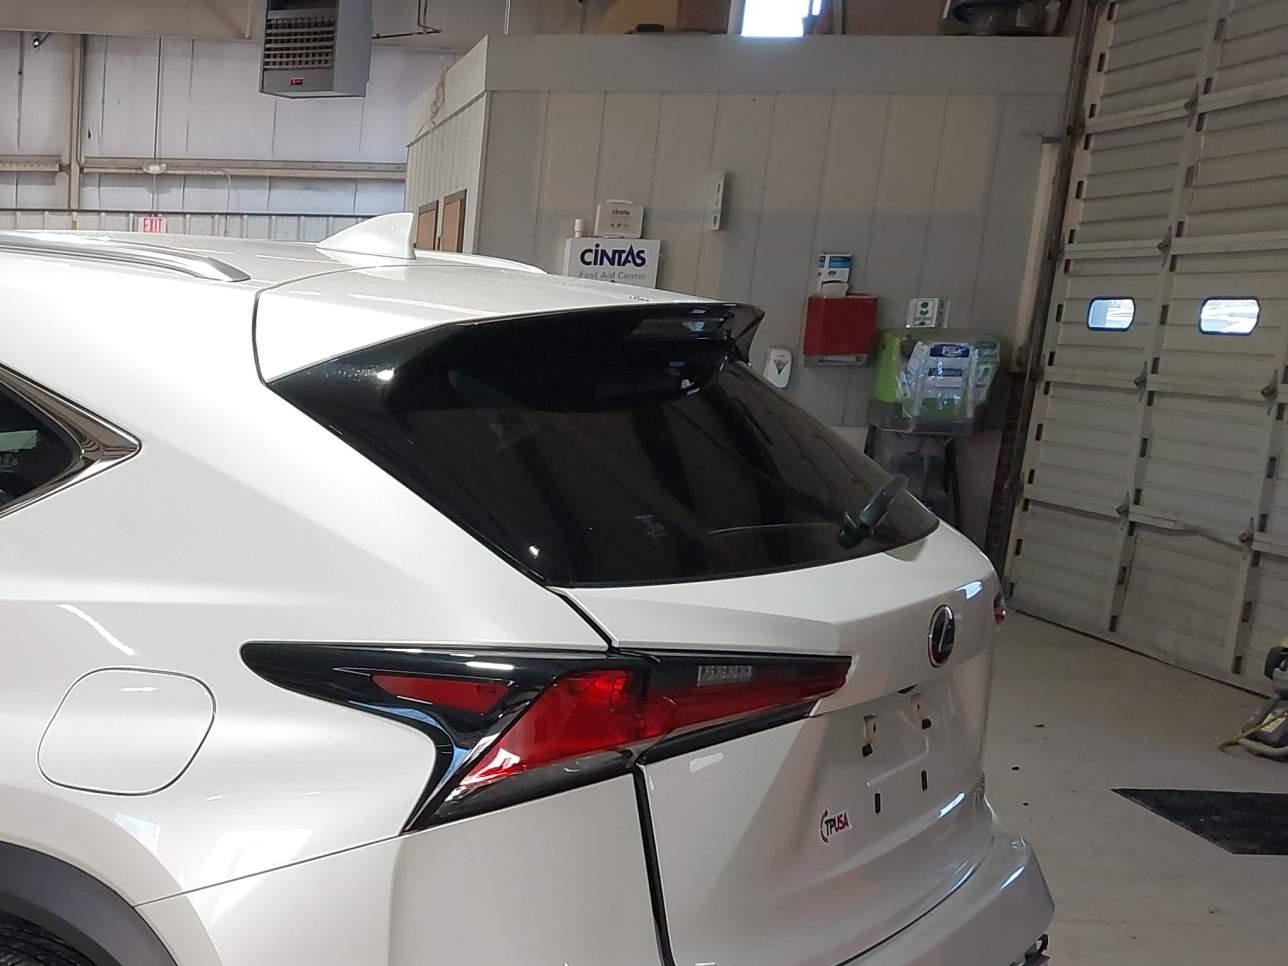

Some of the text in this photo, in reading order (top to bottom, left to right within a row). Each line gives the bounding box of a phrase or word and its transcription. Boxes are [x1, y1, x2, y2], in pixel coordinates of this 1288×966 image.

[143, 217, 162, 233] EXIT
[579, 243, 647, 268] CINTAS
[579, 271, 647, 280] First Aid Center
